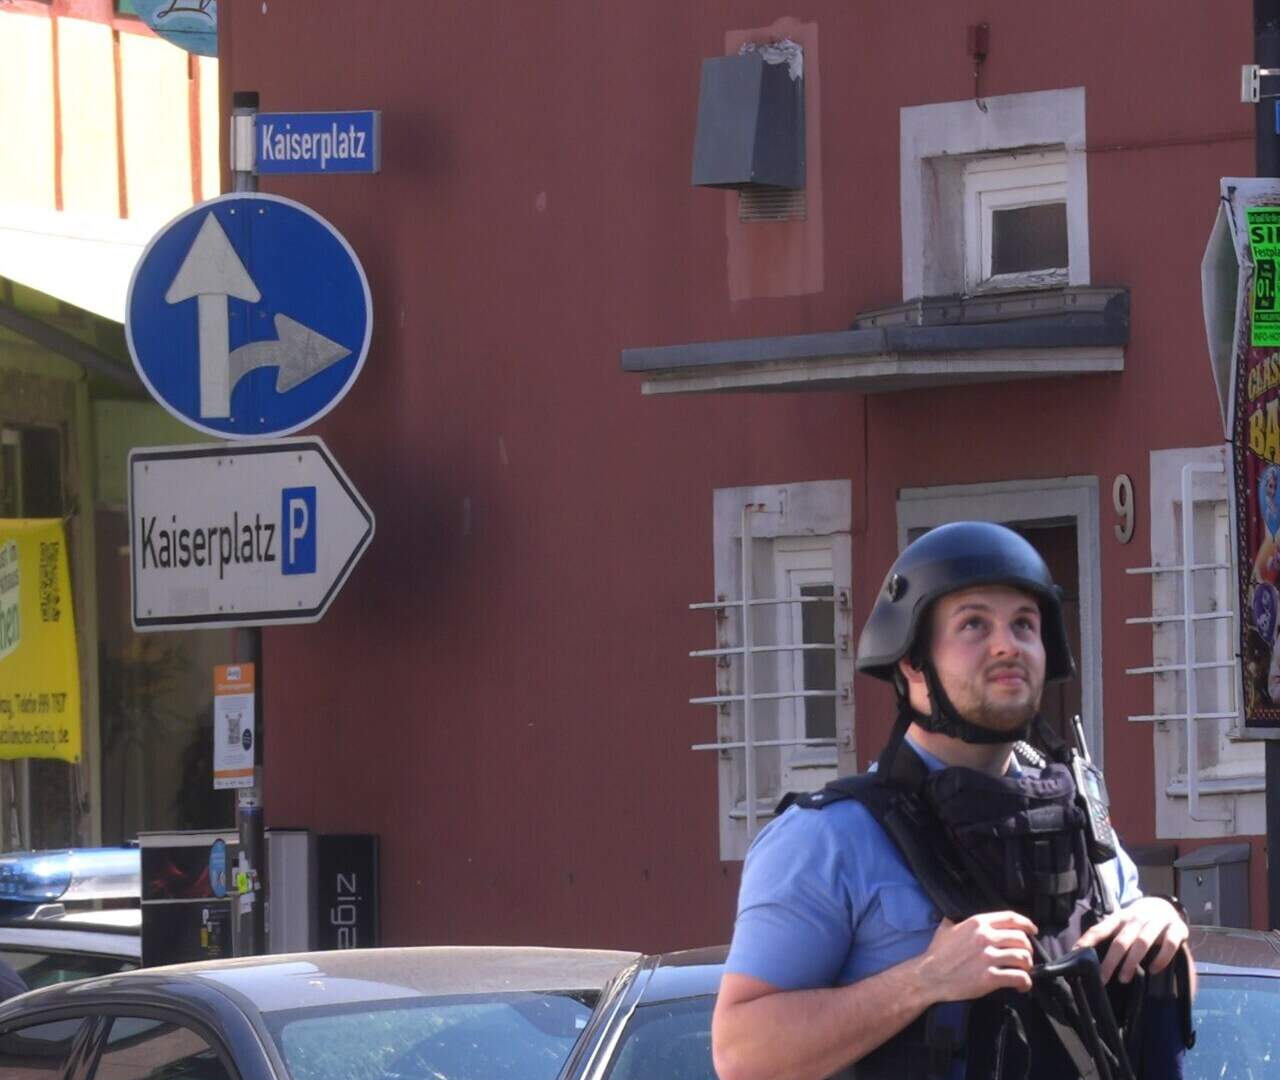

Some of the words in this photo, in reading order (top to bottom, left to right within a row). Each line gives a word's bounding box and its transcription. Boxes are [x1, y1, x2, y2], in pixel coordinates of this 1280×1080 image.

[263, 122, 366, 169] Kaiserplatz
[141, 511, 276, 580] Kaiserplatz
[289, 498, 308, 565] P
[1113, 473, 1135, 544] 9
